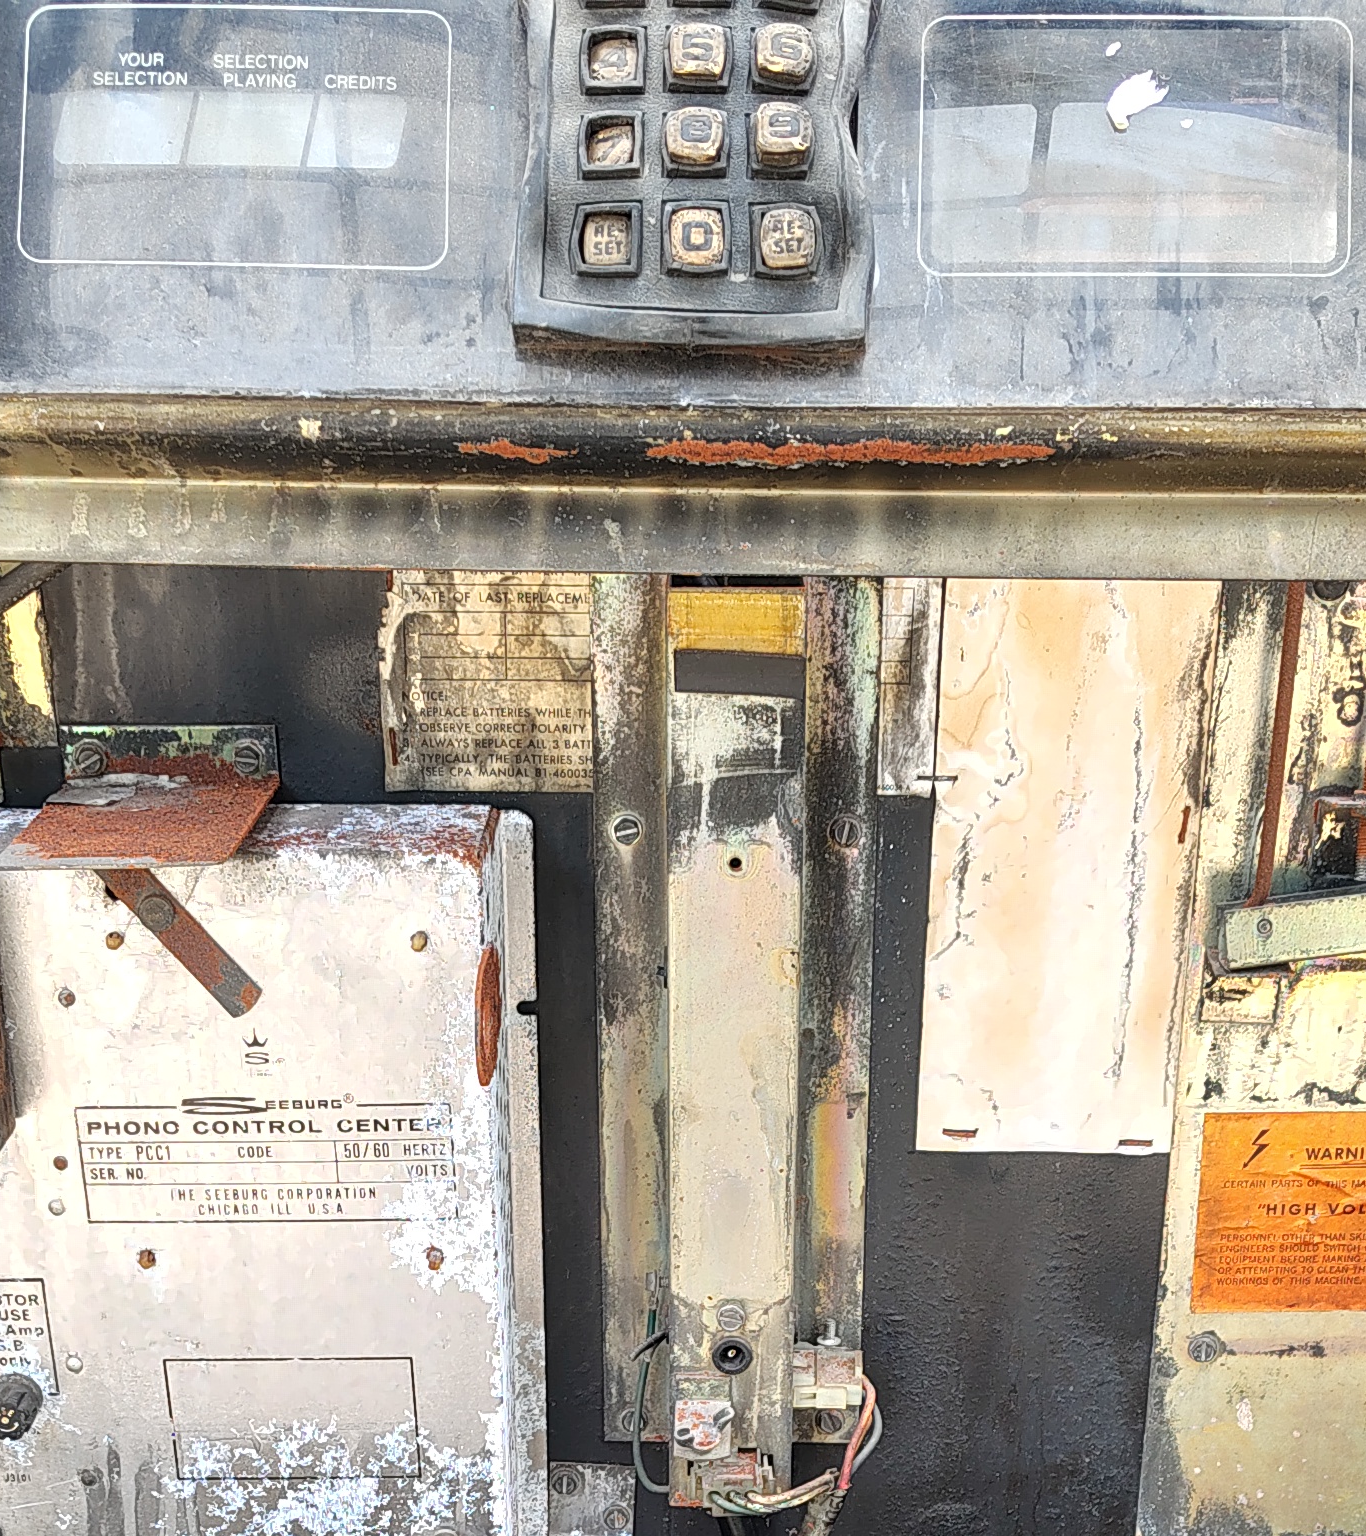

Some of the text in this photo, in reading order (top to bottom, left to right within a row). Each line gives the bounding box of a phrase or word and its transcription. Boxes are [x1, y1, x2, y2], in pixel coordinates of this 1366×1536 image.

[118, 52, 164, 68] YOUR
[213, 54, 309, 71] SELECTION
[92, 71, 189, 87] SELECTION
[223, 73, 297, 89] PLAYING
[324, 75, 398, 91] CREDITS
[592, 240, 624, 256] SET
[772, 238, 804, 255] SET
[452, 591, 471, 603] OF
[479, 591, 508, 603] LAST
[419, 707, 468, 718] REPLACE
[472, 707, 531, 718] BATTERIES
[535, 708, 572, 719] WHILE
[419, 722, 586, 735] OBSERVE CORRECT POLARITY
[420, 738, 469, 749] ALWAYS
[475, 739, 523, 750] REPLACE
[526, 739, 548, 750] ALL
[552, 739, 560, 750] 3
[488, 754, 510, 764] THE
[515, 754, 573, 765] BATTERIES
[449, 767, 473, 778] CPA
[478, 767, 530, 778] MANUAL
[180, 1096, 343, 1115] SEEBURG
[86, 1119, 181, 1136] PHONO
[192, 1118, 324, 1135] CONTROL
[87, 1142, 447, 1161] TYPE PCC1 CODE 50/60 HERTZ
[89, 1166, 119, 1181] SER.
[1223, 1178, 1266, 1190] CERTAIN
[1271, 1178, 1303, 1189] PARTS
[1307, 1178, 1321, 1189] OF
[1324, 1178, 1347, 1189] THIS
[170, 1186, 377, 1202] THE SEEBURG CORPORATION
[197, 1203, 260, 1217] CHICAGO
[1220, 1232, 1277, 1243] PERSONNEL
[1281, 1232, 1316, 1242] OTHER
[1320, 1232, 1346, 1242] THAN
[1219, 1243, 1276, 1253] ENGINEERS
[1278, 1243, 1320, 1253] SHOULD
[1323, 1243, 1361, 1253] SWITCH
[1218, 1254, 1276, 1265] EQUIPMENT
[1280, 1254, 1319, 1264] BEFORE
[1322, 1254, 1361, 1263] MAKING
[1217, 1265, 1232, 1276] OR
[1235, 1265, 1298, 1275] ATTEMPTING
[1301, 1265, 1314, 1275] TO
[1316, 1265, 1349, 1275] CLEAN
[1217, 1276, 1269, 1287] WORKINGS
[1272, 1276, 1285, 1286] OF
[1289, 1276, 1312, 1286] THIS
[5, 1324, 45, 1338] Amp
